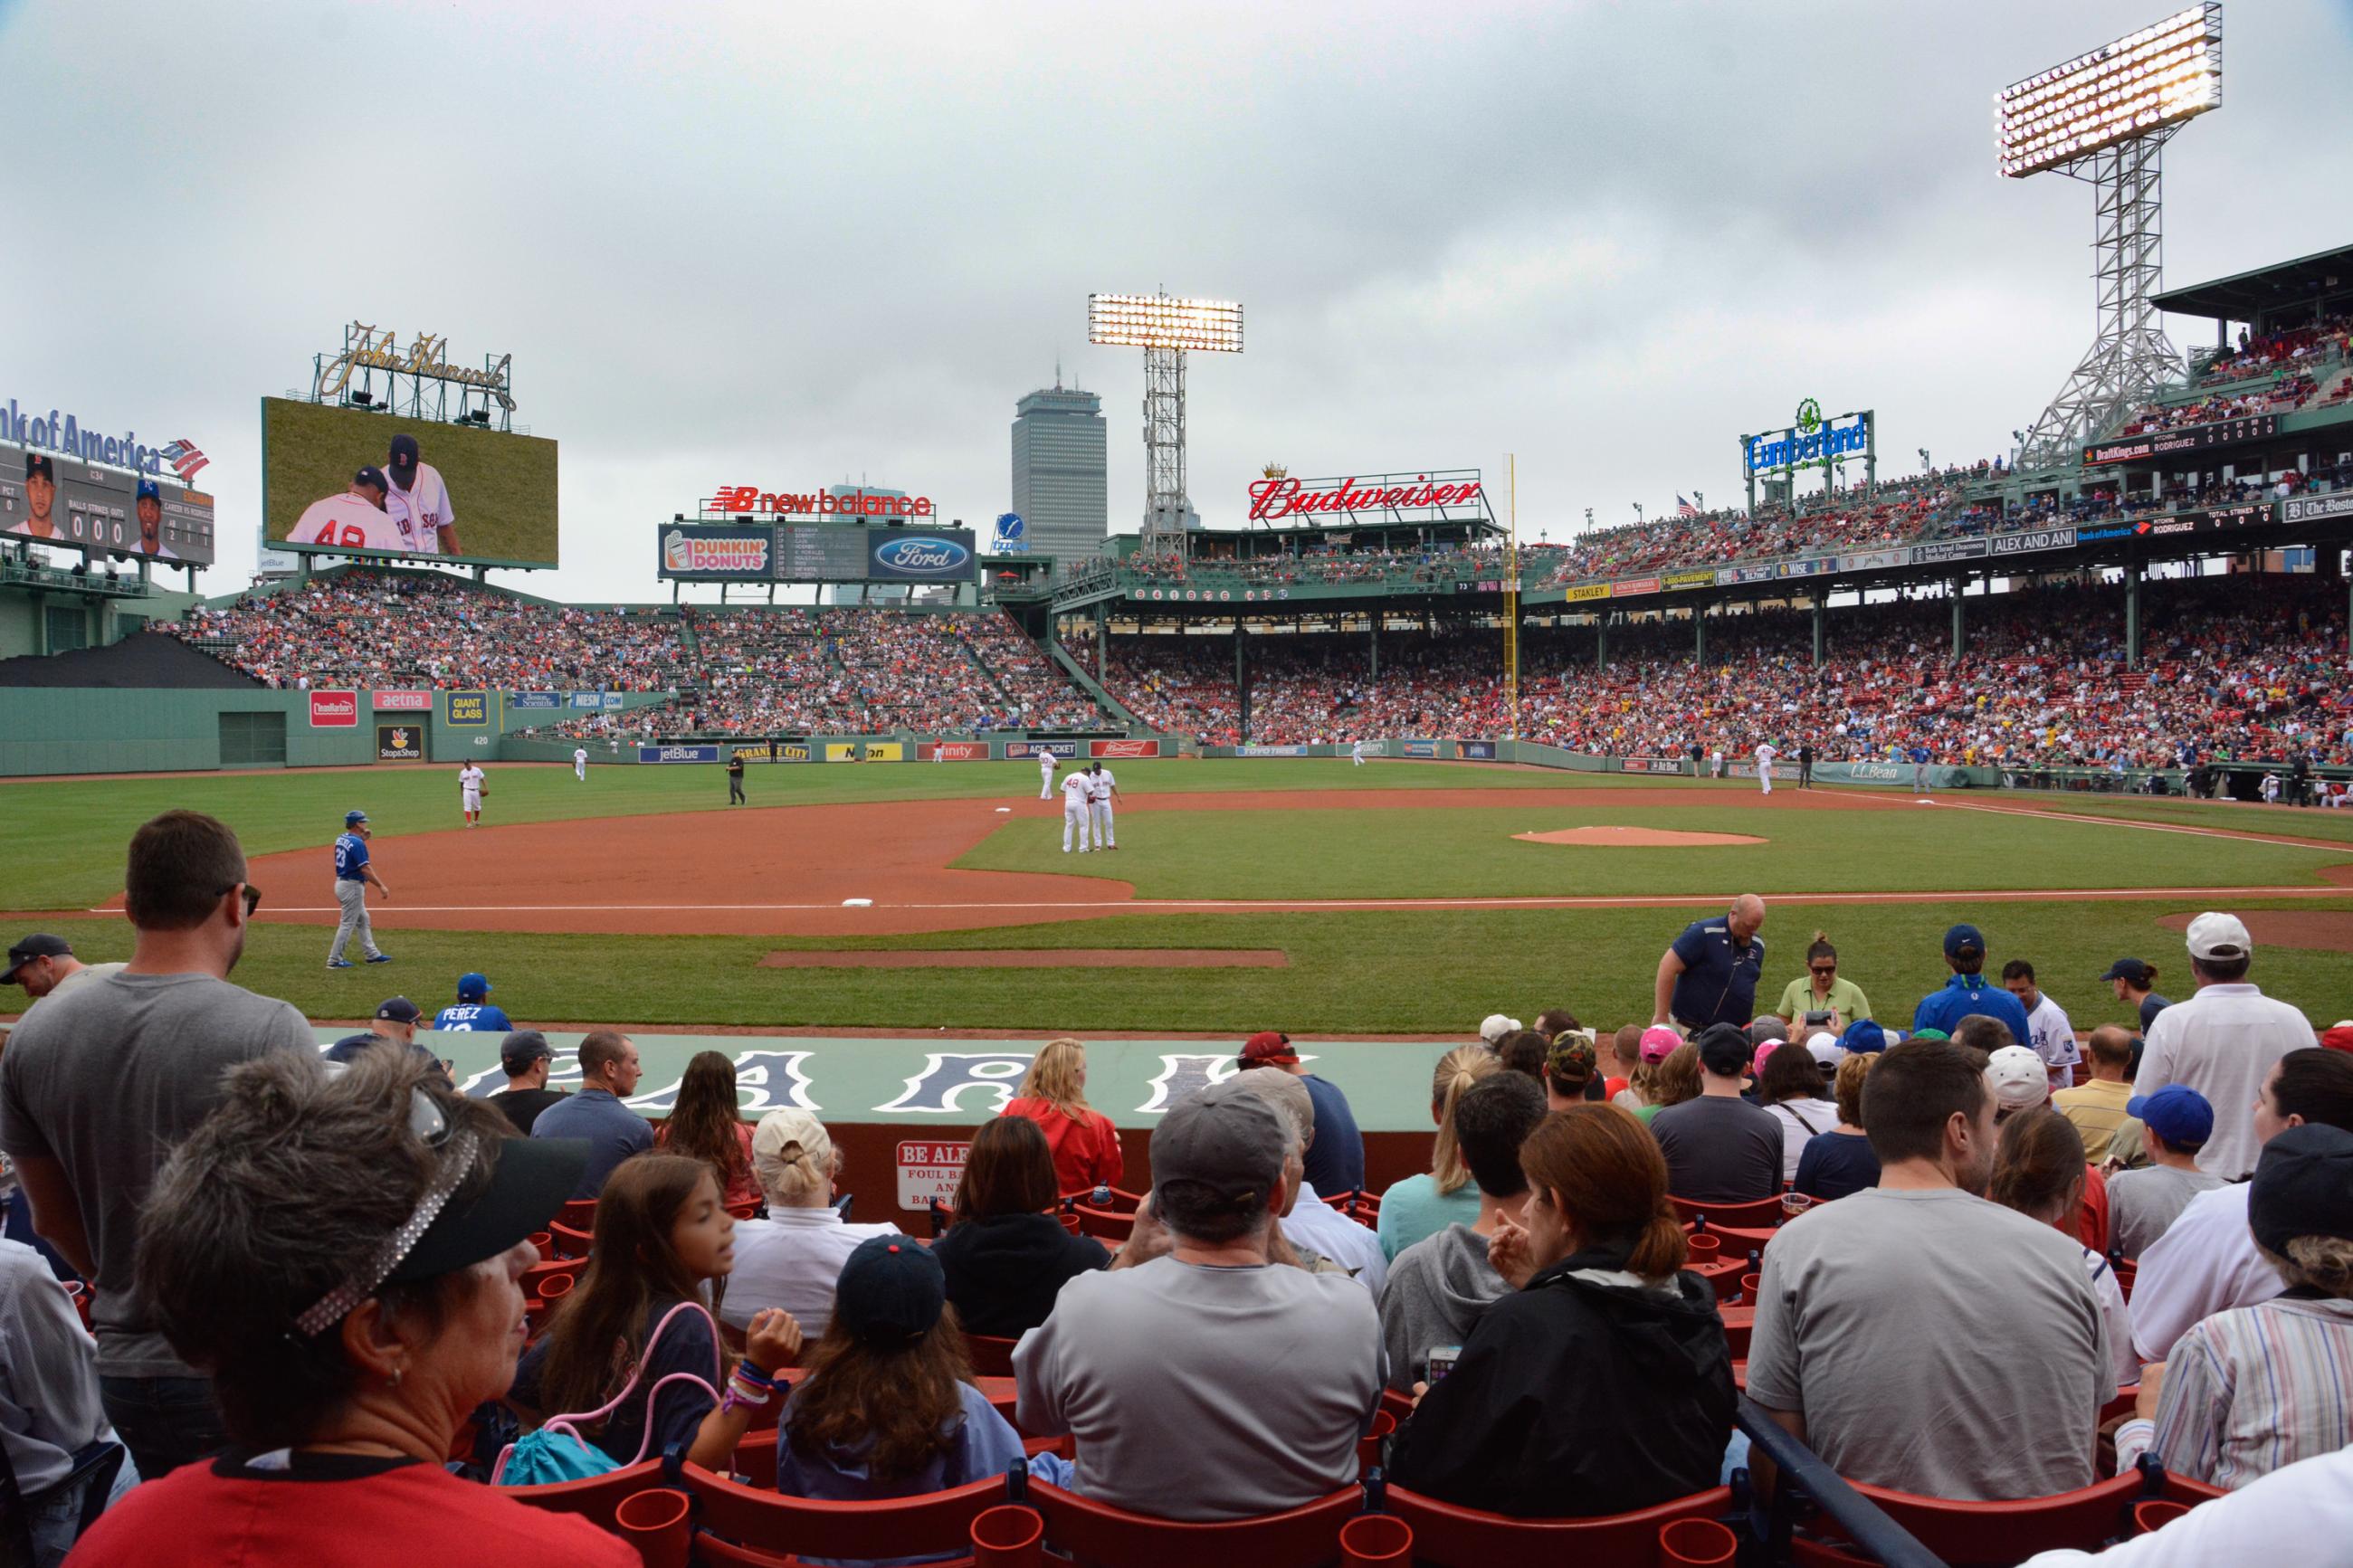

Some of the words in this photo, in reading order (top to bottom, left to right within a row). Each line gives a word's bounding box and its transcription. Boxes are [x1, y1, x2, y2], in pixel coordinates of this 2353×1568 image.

[319, 319, 403, 396] John
[401, 331, 517, 411] Hancock
[2207, 434, 2213, 443] 0
[2223, 432, 2228, 441] 0
[2237, 430, 2243, 438] 0
[2252, 427, 2257, 435] 0
[2267, 424, 2272, 433] 0
[31, 409, 61, 451] of
[63, 413, 161, 476] America
[1748, 412, 1864, 470] Cumberland
[2154, 438, 2195, 451] RODRIGUEZ
[2096, 443, 2149, 461] DraftKings.com
[1770, 454, 1844, 475] FARMS
[761, 492, 816, 514] new
[819, 488, 931, 516] balance
[1249, 475, 1481, 520] Budweiser
[6, 500, 13, 511] 0
[69, 499, 87, 511] BALLS
[88, 504, 110, 515] STRIKES
[110, 508, 124, 518] OUTS
[164, 502, 183, 513] CAREER
[2208, 509, 2228, 518] TOTAL
[2229, 507, 2253, 516] STRIKES
[2259, 504, 2272, 512] PCT
[2306, 501, 2324, 516] The
[2215, 518, 2221, 527] 0
[2238, 515, 2244, 524] 0
[2262, 512, 2269, 522] 0
[73, 516, 83, 537] 0
[93, 519, 103, 541] 0
[113, 523, 122, 543] 0
[169, 530, 175, 540] 2
[315, 519, 366, 548] 48
[2077, 531, 2095, 541] Bank
[2095, 529, 2102, 540] of
[2102, 527, 2132, 538] America
[2154, 522, 2195, 535] RODRIGUEZ
[694, 540, 767, 554] DUNKIN'
[1925, 546, 1938, 555] Beth
[1955, 542, 1985, 552] Deaconess
[1995, 537, 2022, 553] ALEX
[2024, 535, 2049, 549] AND
[2051, 531, 2072, 546] ANI
[693, 555, 763, 568] DONUTS
[893, 542, 950, 568] Ford
[1926, 553, 1947, 562] Medical
[1948, 551, 1967, 559] Center
[1788, 562, 1807, 575] WISE
[1573, 588, 1605, 599] STANLEY
[383, 693, 423, 707] aetna
[453, 698, 481, 708] GIANT
[522, 698, 555, 708] Scientific
[527, 692, 548, 701] Boston
[576, 693, 601, 706] NESN
[452, 708, 482, 719] GLASS
[474, 736, 489, 746] 420
[1359, 742, 1384, 753] rdan's
[659, 746, 700, 762] jetBlue
[785, 746, 809, 758] CITY
[845, 746, 884, 758] Non
[941, 745, 973, 758] finity
[1029, 745, 1046, 754] ACE
[1658, 761, 1666, 771] At
[1666, 761, 1679, 772] Bat
[1851, 765, 1898, 779] L.L.Bean
[1066, 778, 1080, 789] 48
[443, 1007, 481, 1021] PEREZ
[902, 1146, 928, 1164] BE
[932, 1145, 970, 1164] ALE
[909, 1169, 945, 1179] FOUL
[911, 1195, 946, 1204] BAS
